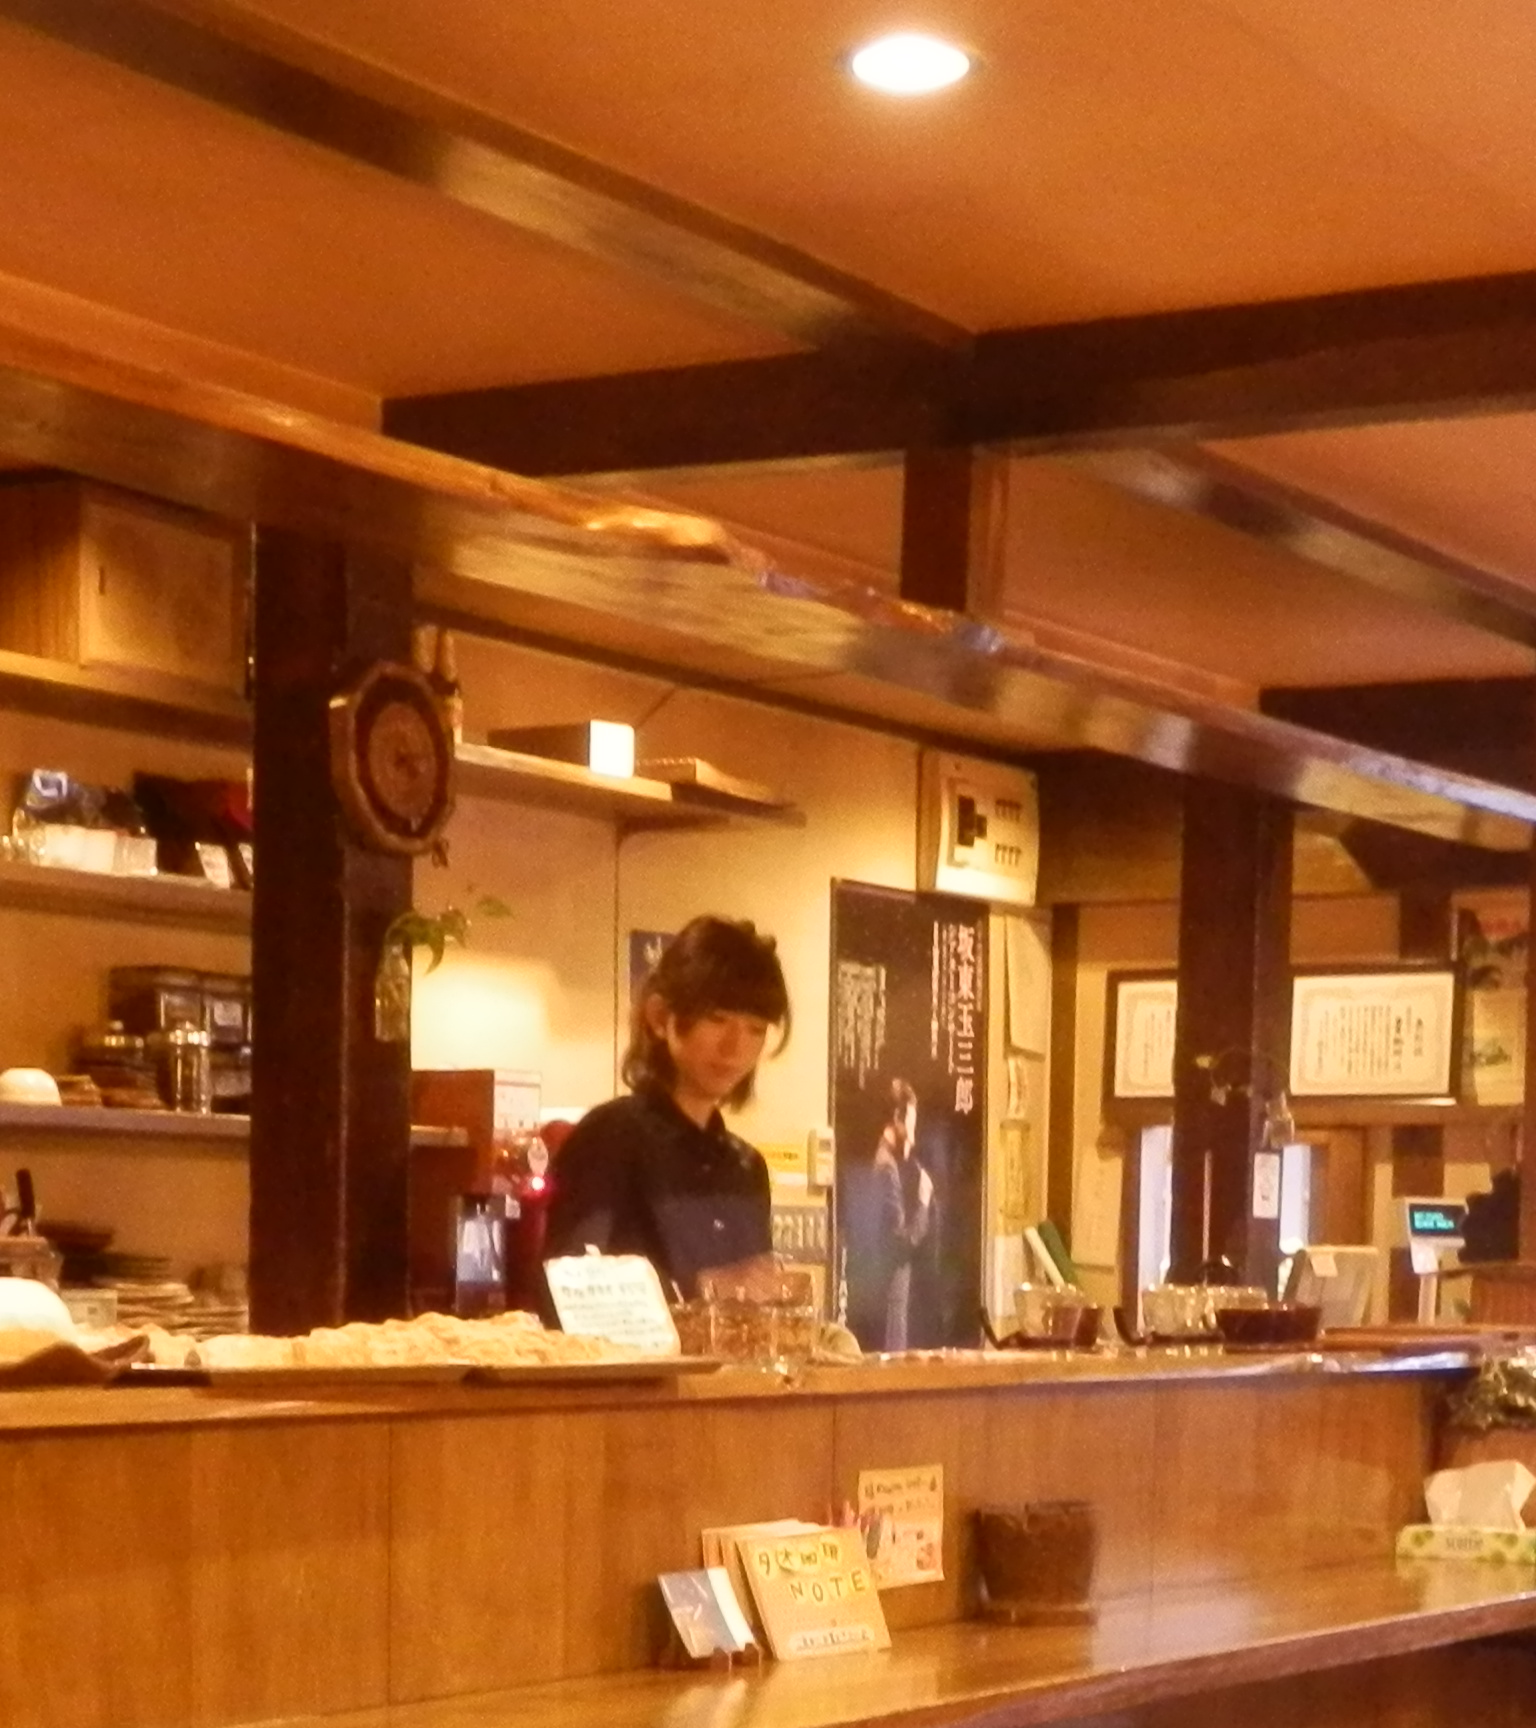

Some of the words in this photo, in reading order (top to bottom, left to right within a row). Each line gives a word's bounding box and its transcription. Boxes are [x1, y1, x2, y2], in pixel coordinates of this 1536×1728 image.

[955, 924, 975, 1114] 坂東玉三郎
[789, 1569, 865, 1602] NOTE
